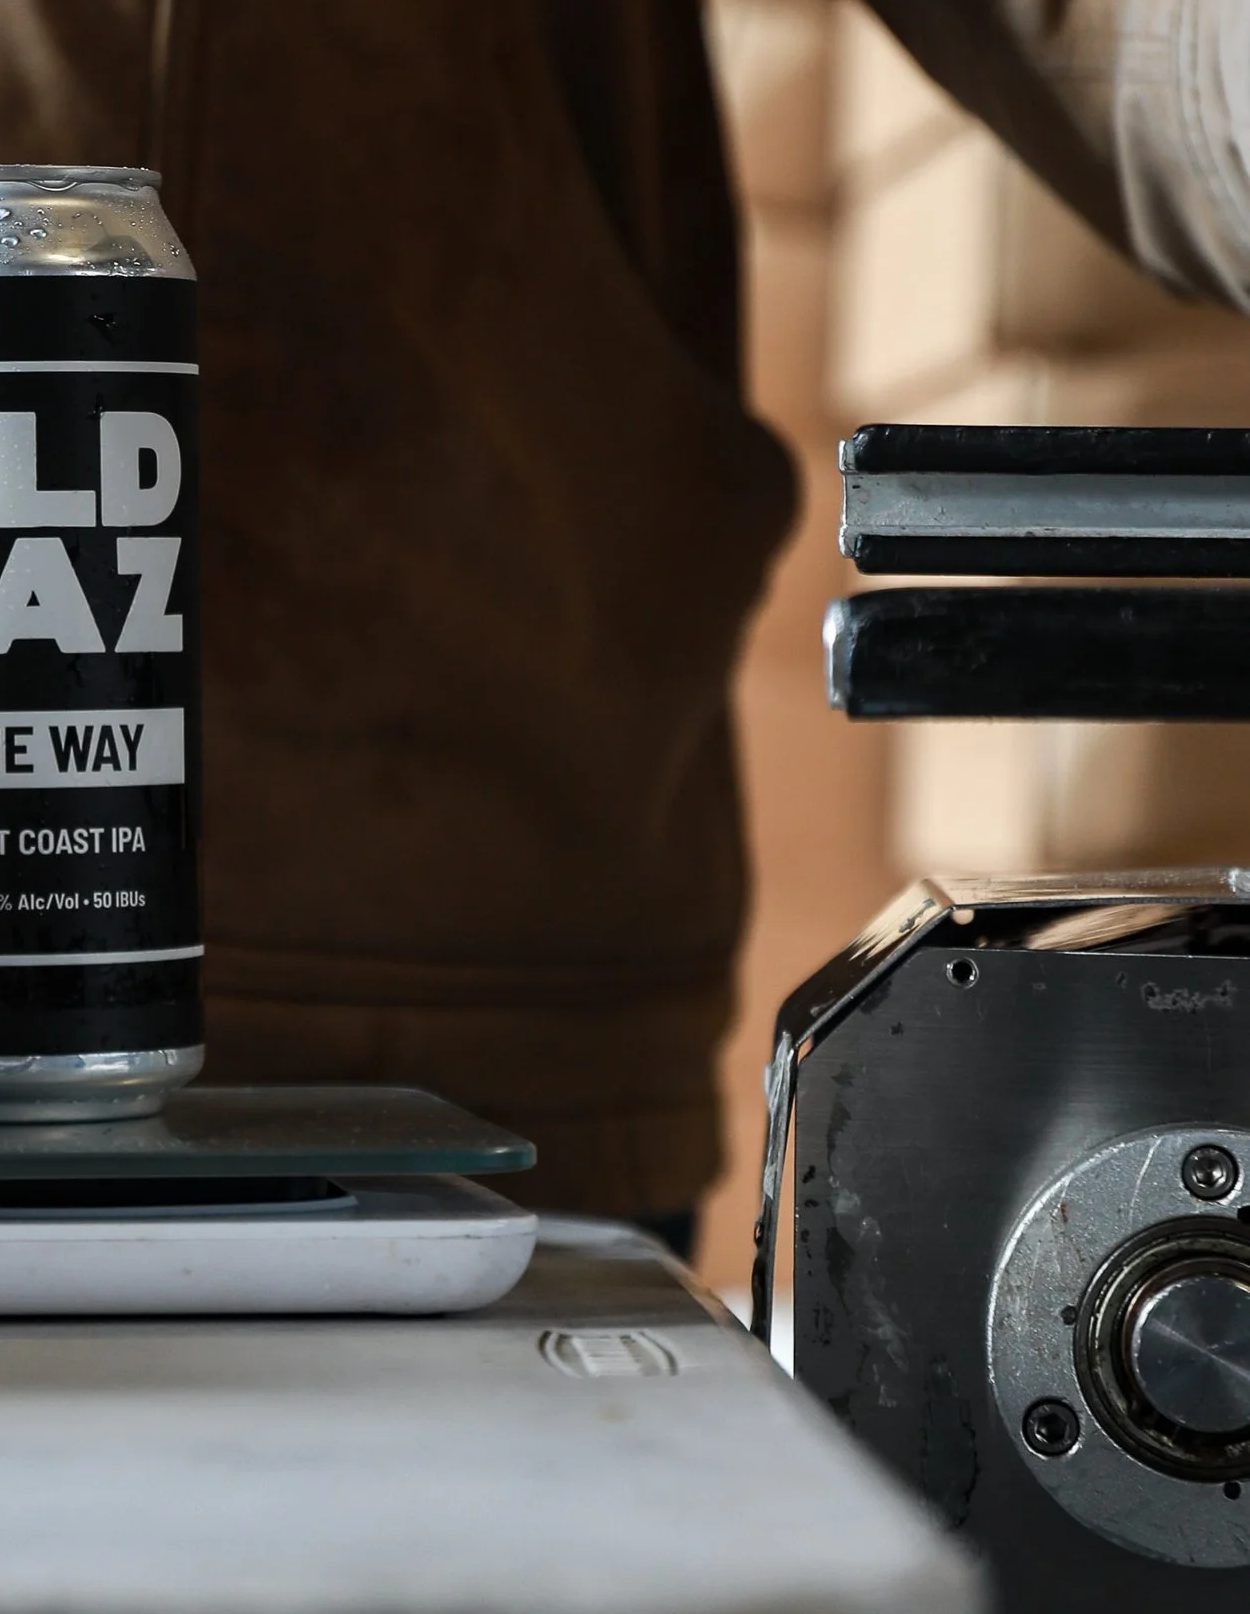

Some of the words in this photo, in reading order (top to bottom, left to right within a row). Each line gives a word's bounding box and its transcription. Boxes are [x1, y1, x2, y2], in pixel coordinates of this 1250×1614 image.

[48, 723, 145, 773] WAY
[19, 827, 105, 855] COAST
[111, 826, 146, 853] IPA
[17, 892, 80, 911] Alc/Vol
[93, 891, 113, 909] 50
[115, 890, 146, 908] IBUs
